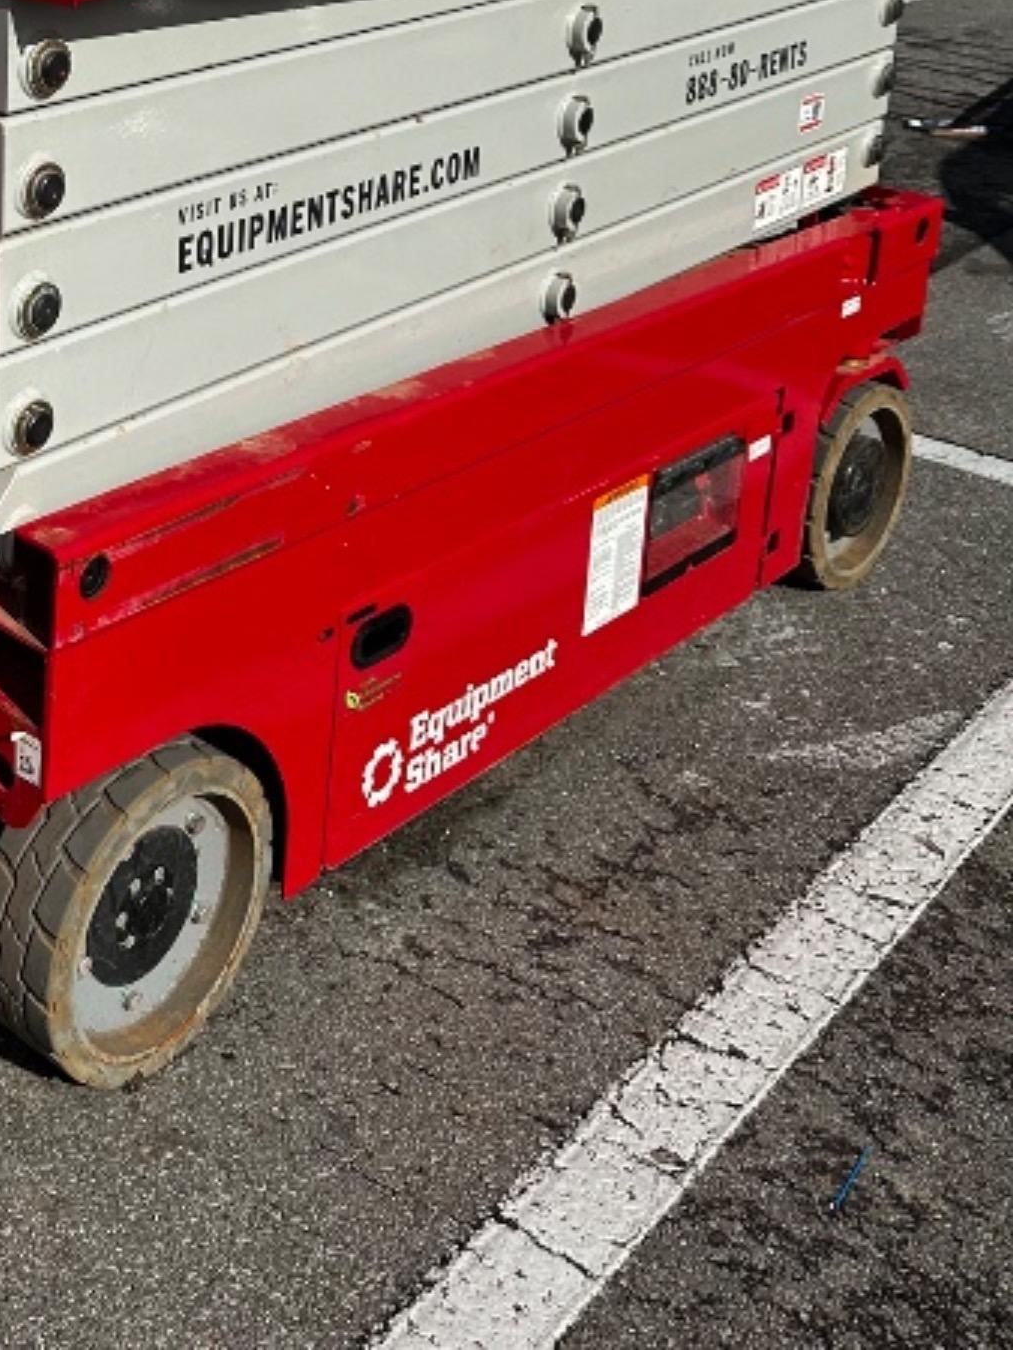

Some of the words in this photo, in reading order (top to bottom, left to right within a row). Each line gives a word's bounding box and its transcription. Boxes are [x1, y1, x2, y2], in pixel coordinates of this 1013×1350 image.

[686, 41, 808, 105] 888-80-RENTS
[178, 197, 222, 225] VISIT
[229, 189, 248, 211] US
[178, 145, 482, 274] EQUIPMENTSHARE.COM
[408, 637, 559, 751] Equipment
[403, 721, 488, 794] Share
